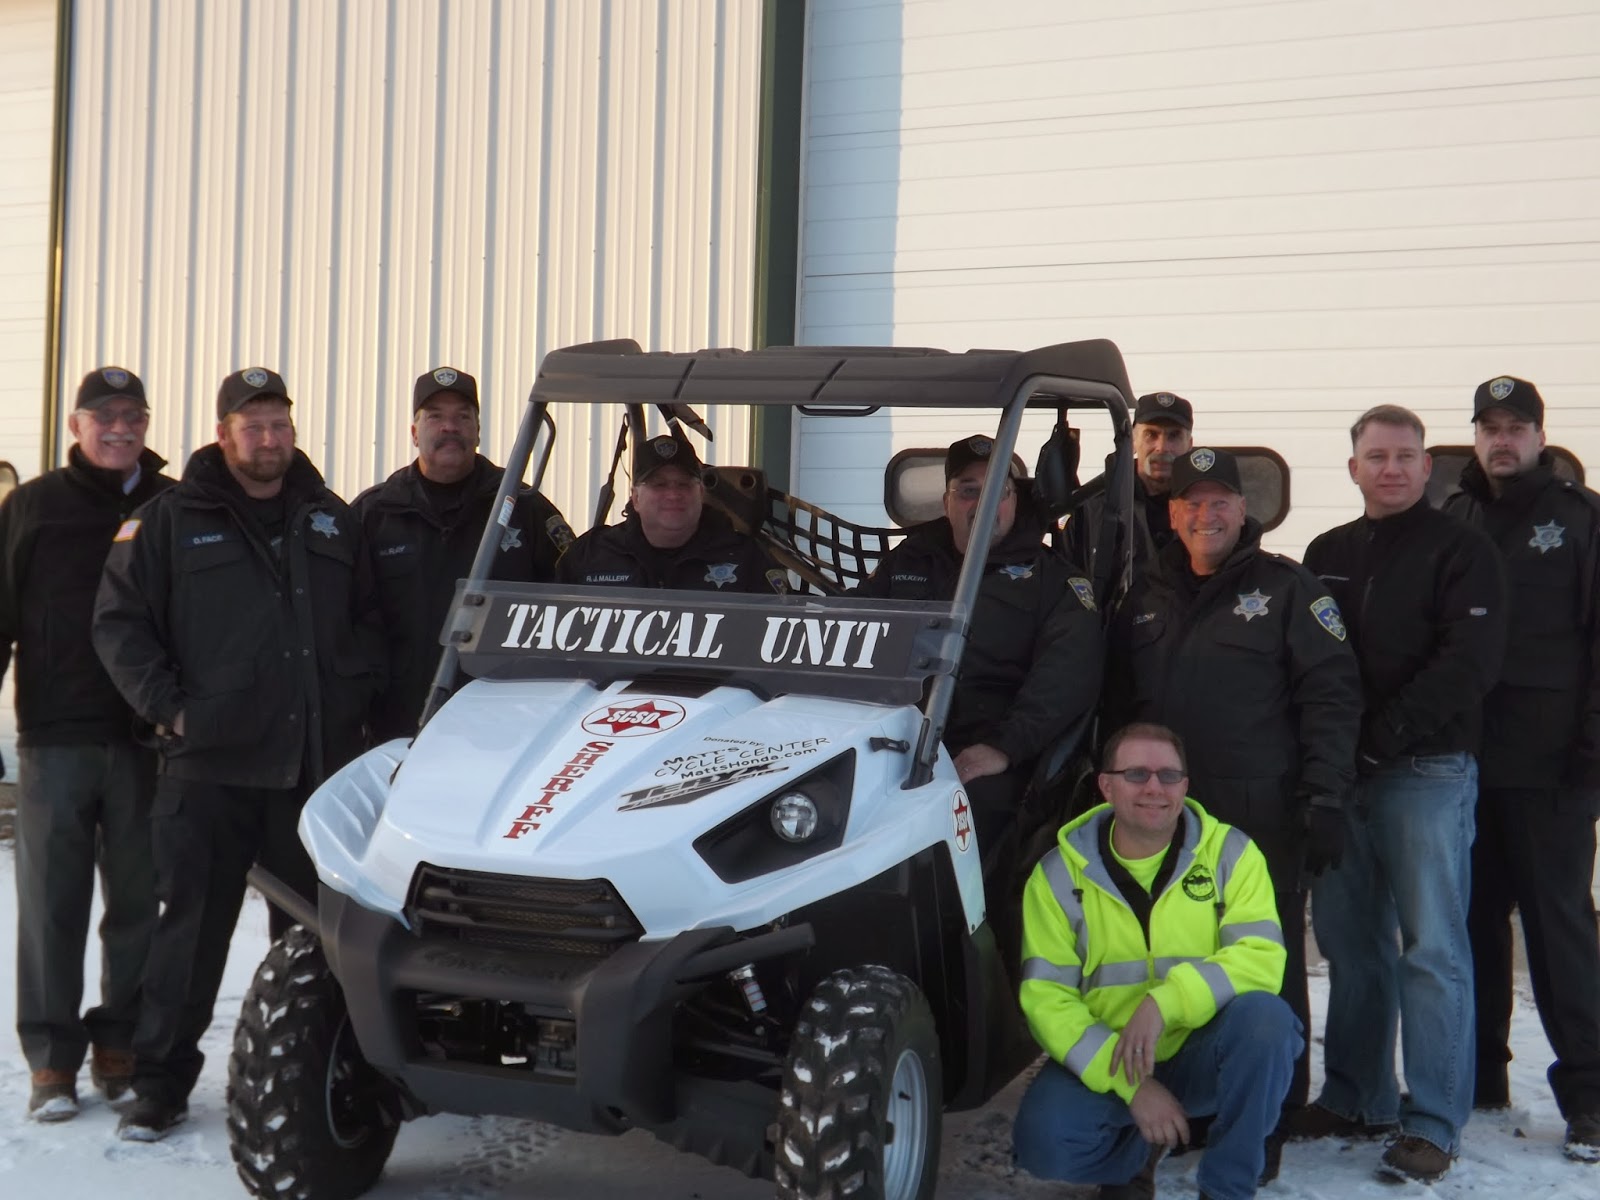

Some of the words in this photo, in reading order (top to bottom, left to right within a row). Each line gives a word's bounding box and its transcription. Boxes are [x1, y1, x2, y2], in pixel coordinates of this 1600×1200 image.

[501, 604, 724, 659] TACTICAL
[760, 617, 890, 668] UNIT
[606, 710, 661, 725] SCSO
[654, 755, 725, 778] CYCLE
[739, 737, 830, 758] CENTER
[703, 736, 748, 745] Donated
[681, 748, 818, 780] MattsHonda.com
[502, 741, 615, 839] SHERIFF
